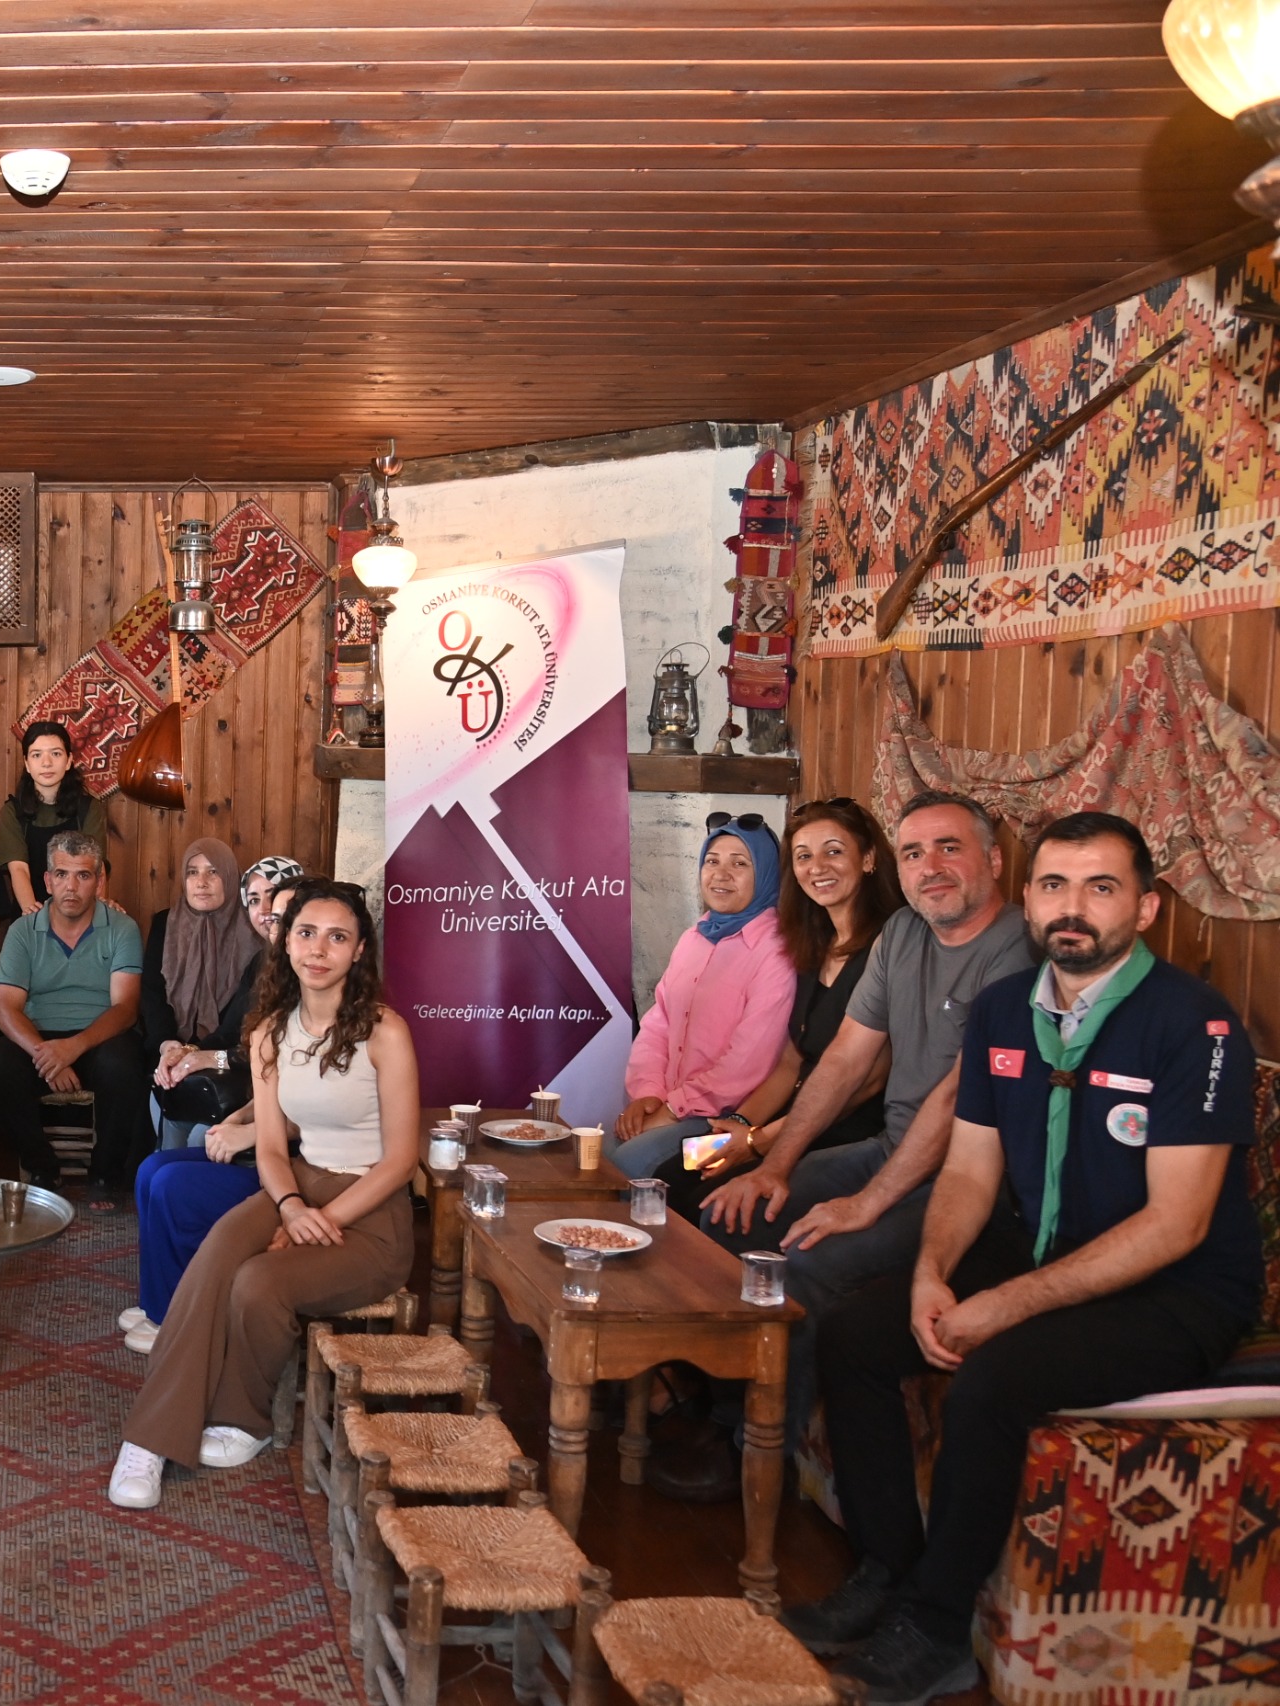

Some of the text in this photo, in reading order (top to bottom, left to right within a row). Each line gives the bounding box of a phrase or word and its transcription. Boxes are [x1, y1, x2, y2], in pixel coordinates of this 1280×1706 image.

[421, 582, 559, 752] OSMANİYE KORKUT ATA ÜNİVERSİTESİ
[387, 875, 625, 906] Osmaniye Korkut Ata
[440, 908, 564, 933] Üniversitesi
[508, 1005, 554, 1022] Açılan
[1203, 1036, 1224, 1112] TÜRKİYE
